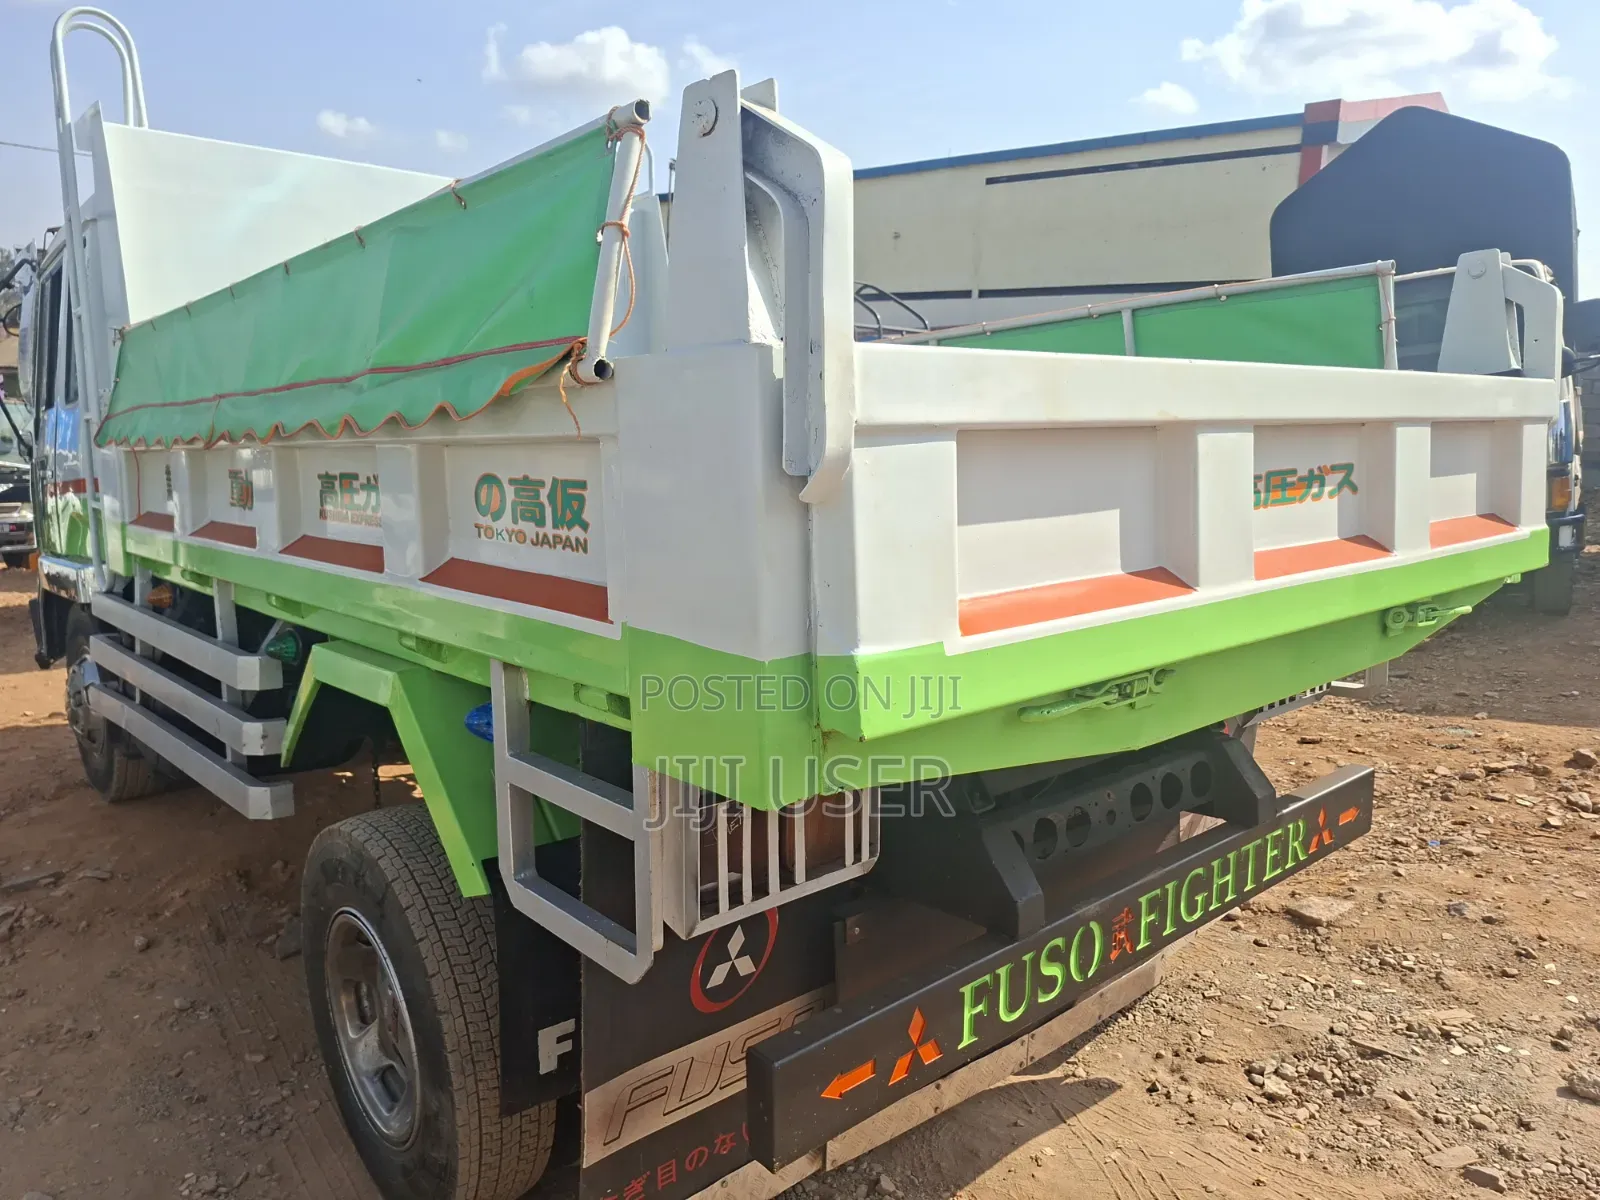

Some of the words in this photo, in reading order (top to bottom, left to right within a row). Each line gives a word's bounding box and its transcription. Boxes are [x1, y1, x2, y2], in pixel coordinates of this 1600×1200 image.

[474, 472, 590, 534] の高仮
[474, 522, 527, 545] TOKYO
[530, 531, 589, 555] JAPAN
[957, 920, 1104, 1051] FUSO
[1135, 818, 1309, 952] FIGHTER
[537, 1018, 576, 1076] F
